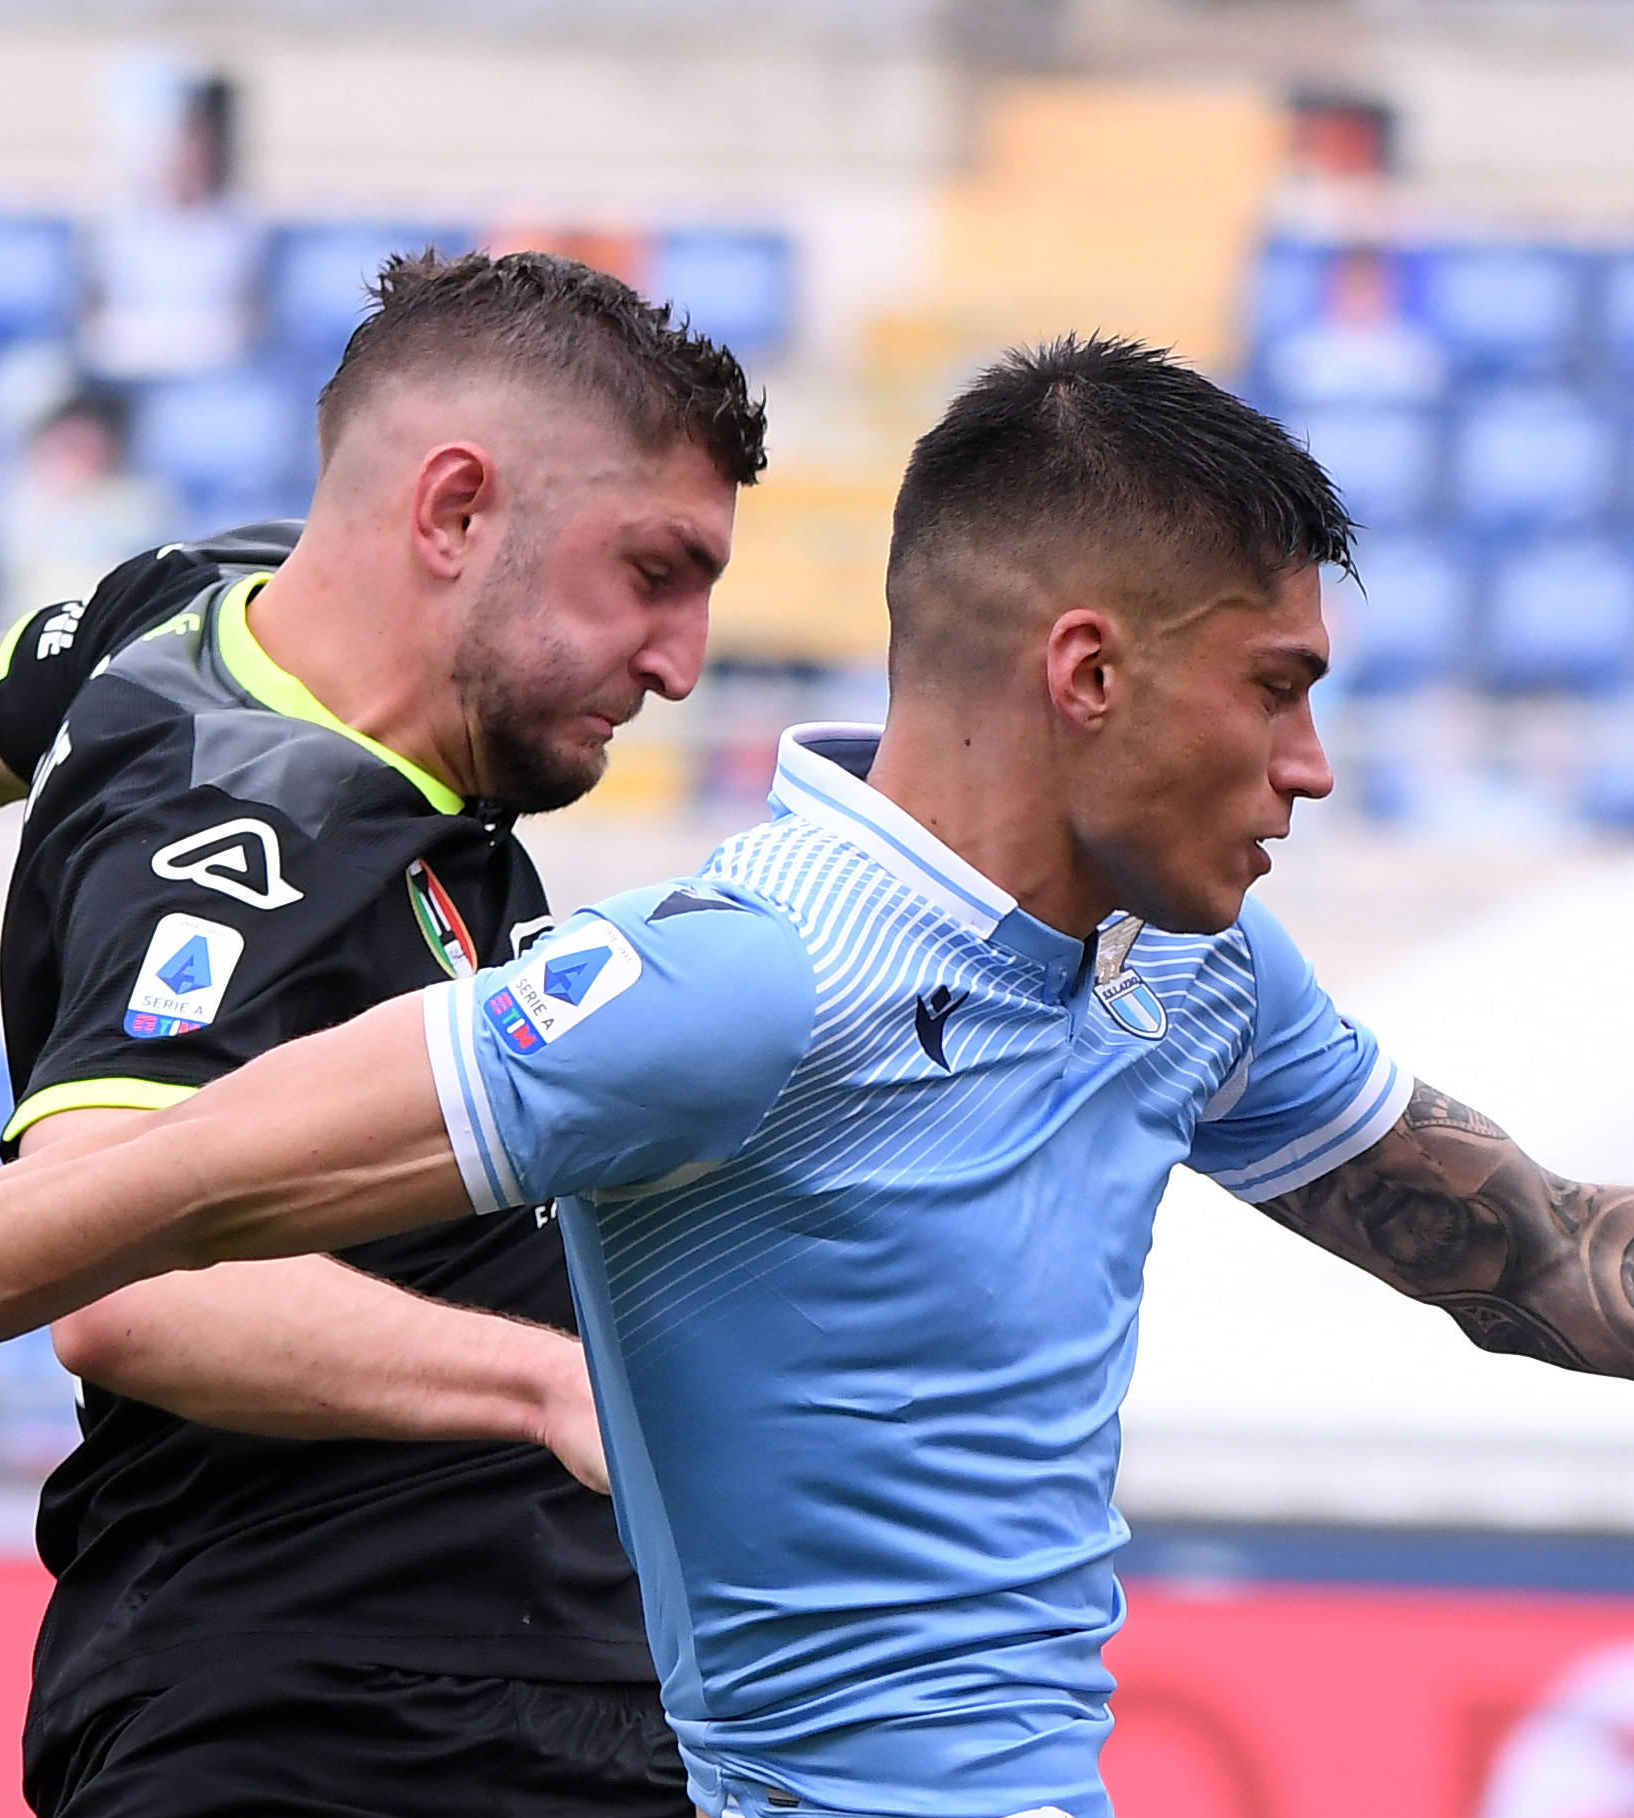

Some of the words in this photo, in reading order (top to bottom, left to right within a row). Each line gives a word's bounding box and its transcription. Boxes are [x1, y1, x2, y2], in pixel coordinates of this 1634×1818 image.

[142, 995, 190, 1013] SERIE
[194, 1005, 204, 1015] A
[516, 978, 548, 1017] SERIE
[541, 1017, 555, 1031] A
[502, 1008, 537, 1049] TIM
